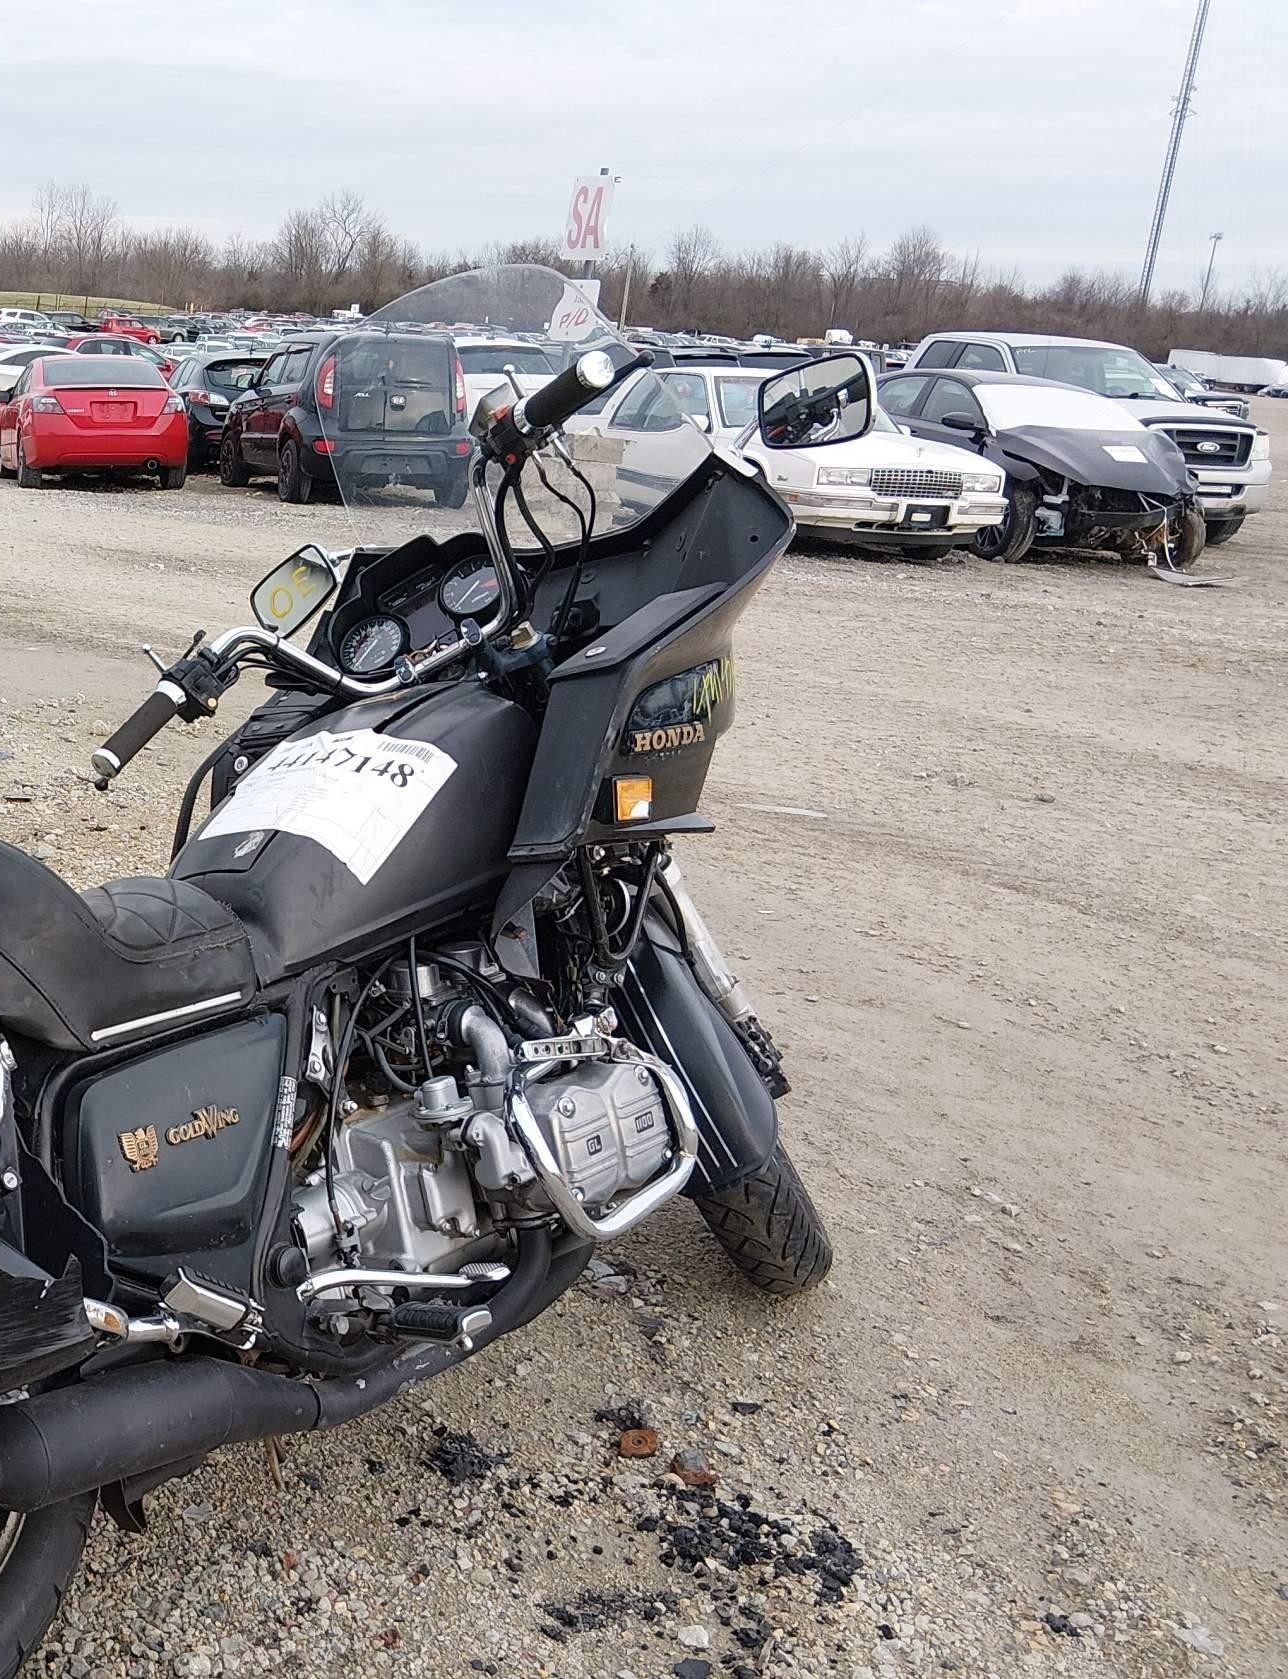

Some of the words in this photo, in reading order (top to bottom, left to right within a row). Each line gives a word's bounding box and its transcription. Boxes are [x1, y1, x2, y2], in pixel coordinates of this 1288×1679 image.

[567, 186, 604, 250] SA
[633, 721, 706, 753] HONDA
[635, 1112, 654, 1131] 1100
[587, 1137, 602, 1154] GL
